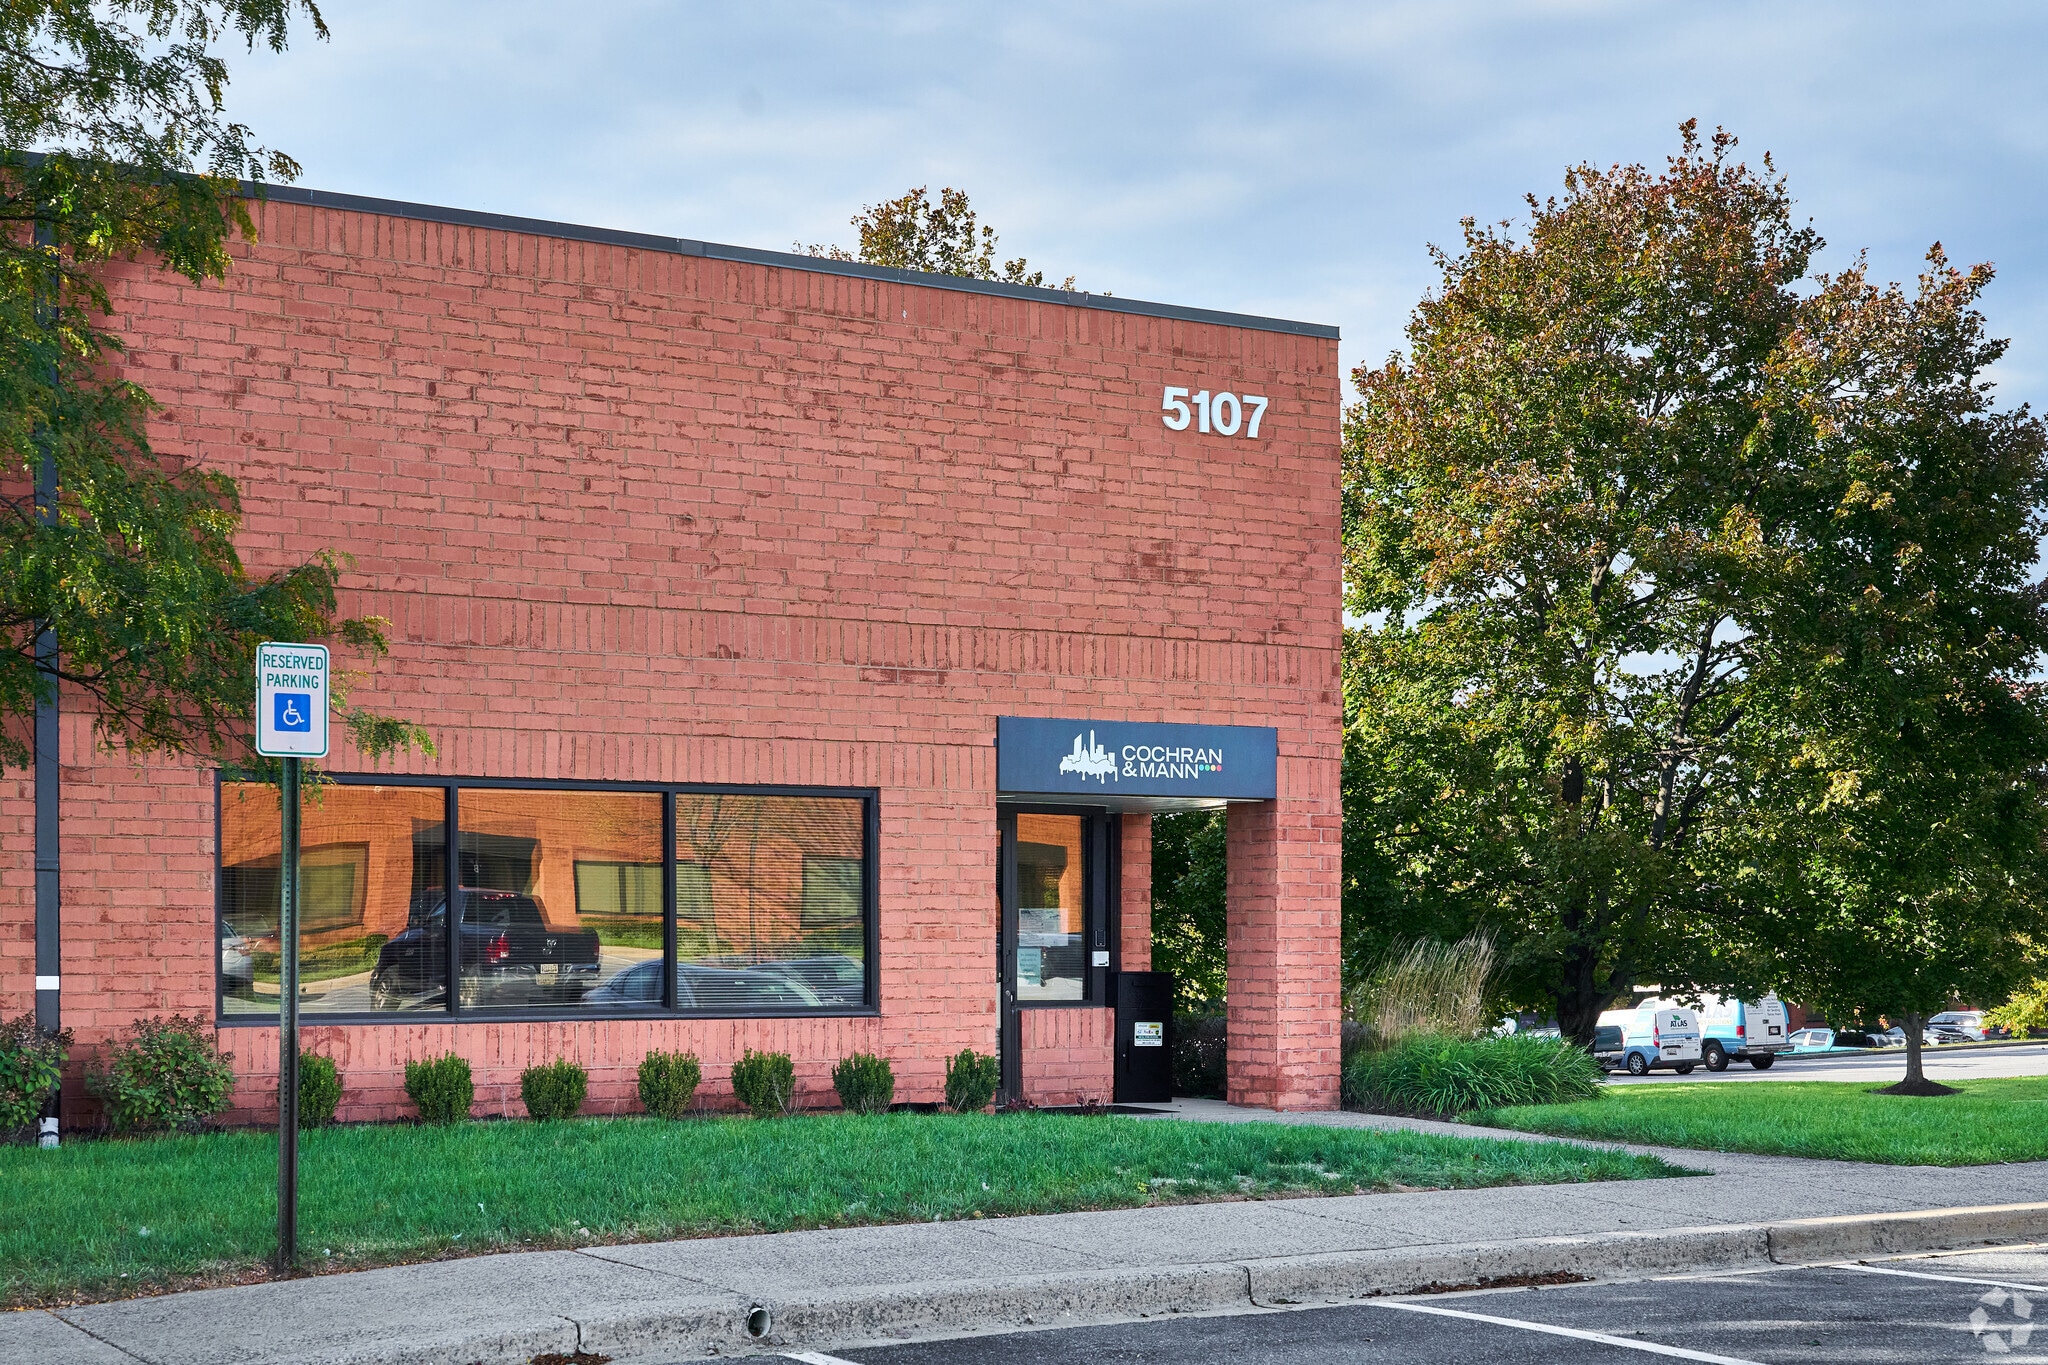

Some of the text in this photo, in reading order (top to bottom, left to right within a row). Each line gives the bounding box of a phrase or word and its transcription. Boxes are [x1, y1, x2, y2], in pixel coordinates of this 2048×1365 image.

[1162, 386, 1269, 438] 5107
[263, 654, 323, 670] RESERVED
[266, 673, 319, 689] PARKING
[1122, 745, 1222, 764] COCHRAN
[1122, 762, 1199, 779] & MANN
[1670, 1019, 1688, 1027] ATLAS
